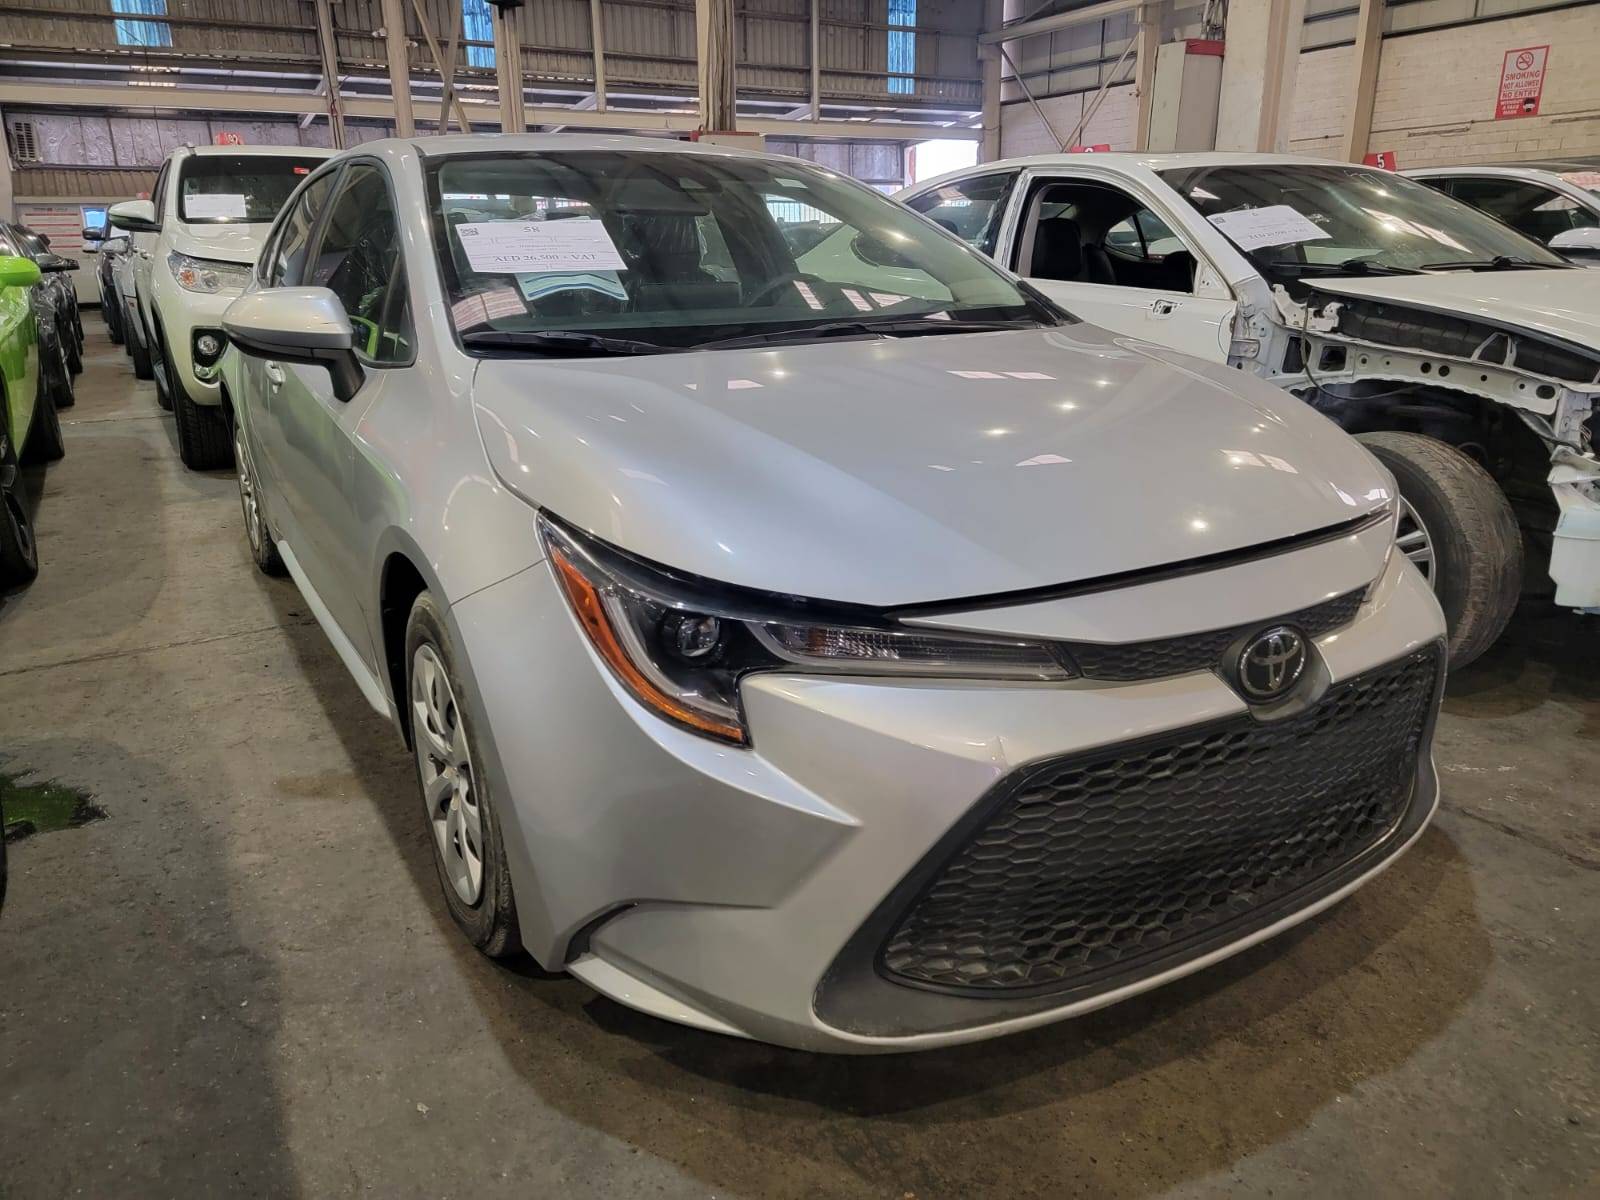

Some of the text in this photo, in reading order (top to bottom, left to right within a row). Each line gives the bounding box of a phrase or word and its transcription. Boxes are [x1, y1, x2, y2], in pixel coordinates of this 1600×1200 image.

[1505, 71, 1540, 81] SMOKING
[1515, 80, 1539, 88] ALLOWED
[1514, 90, 1537, 98] ENTRY
[1377, 154, 1385, 169] 5
